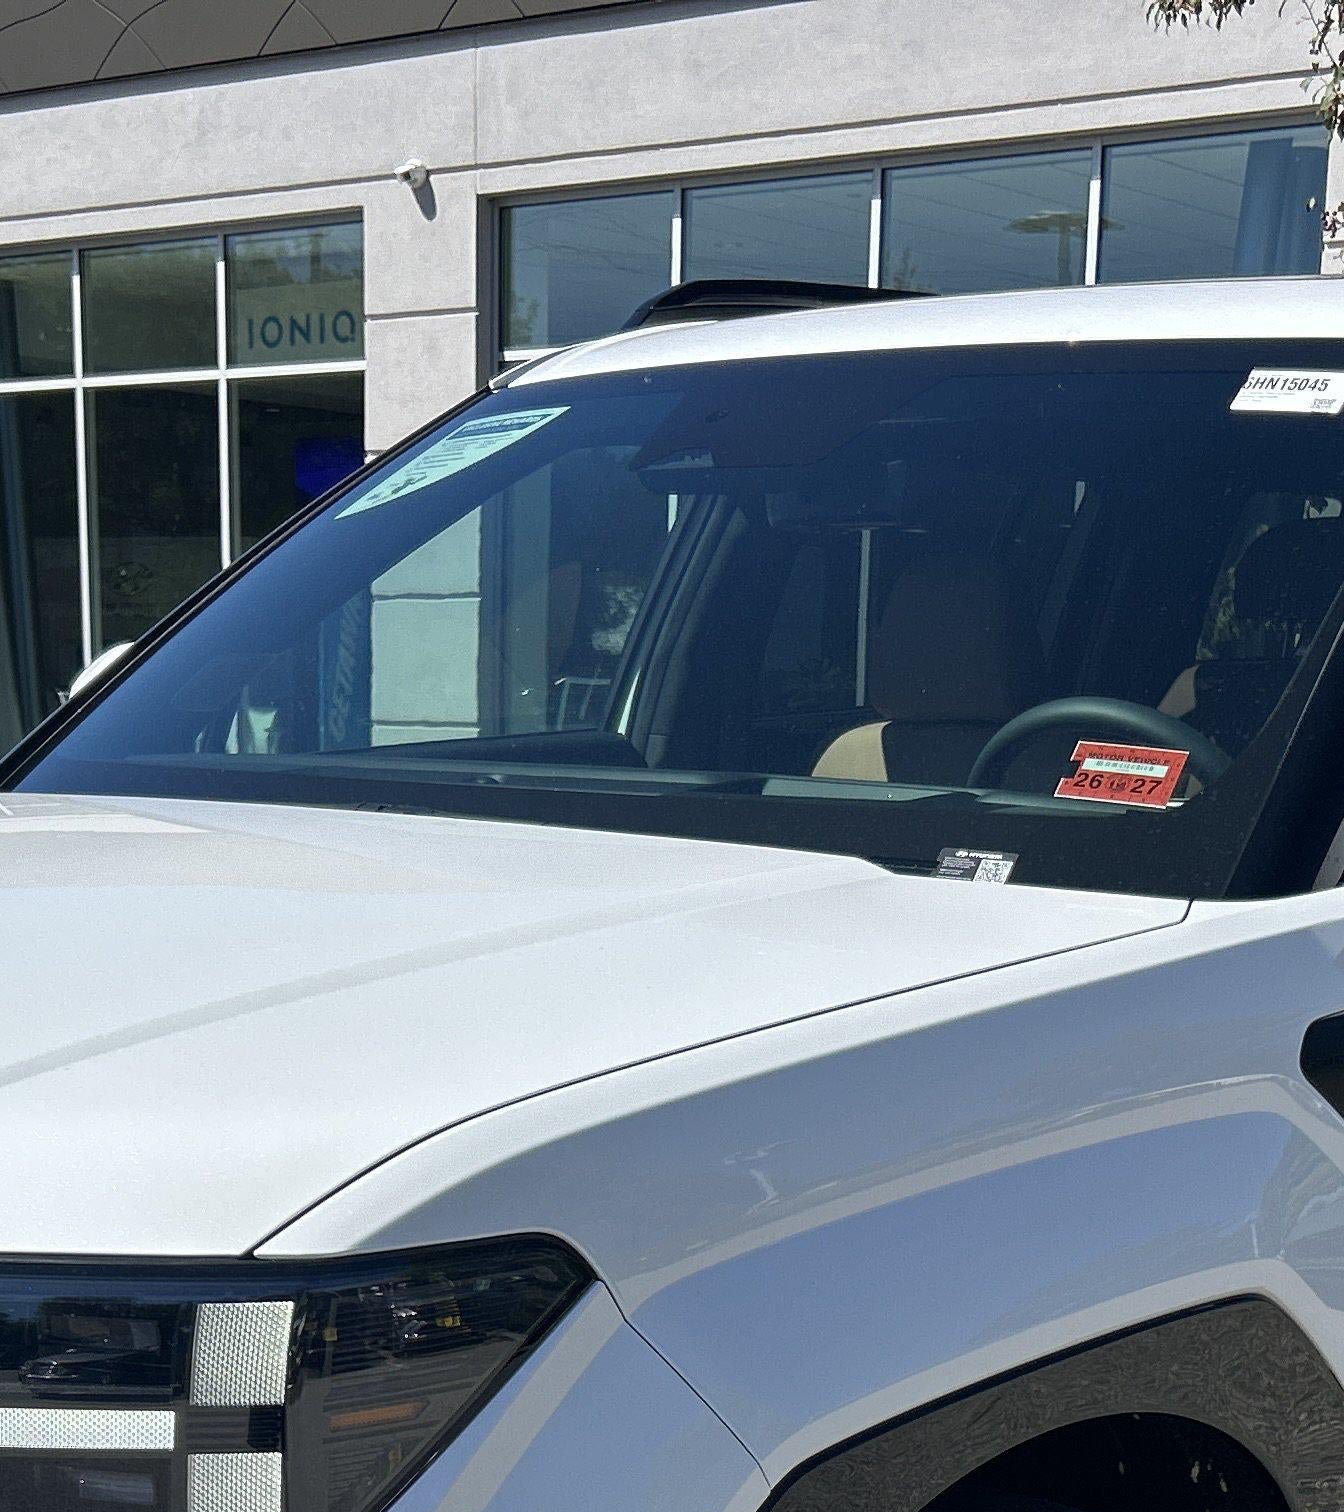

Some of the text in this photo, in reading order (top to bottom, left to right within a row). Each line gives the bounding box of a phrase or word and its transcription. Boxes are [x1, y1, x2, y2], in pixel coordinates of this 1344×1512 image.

[247, 310, 356, 349] IONIQ
[1072, 772, 1104, 789] 26
[1129, 778, 1162, 795] 27
